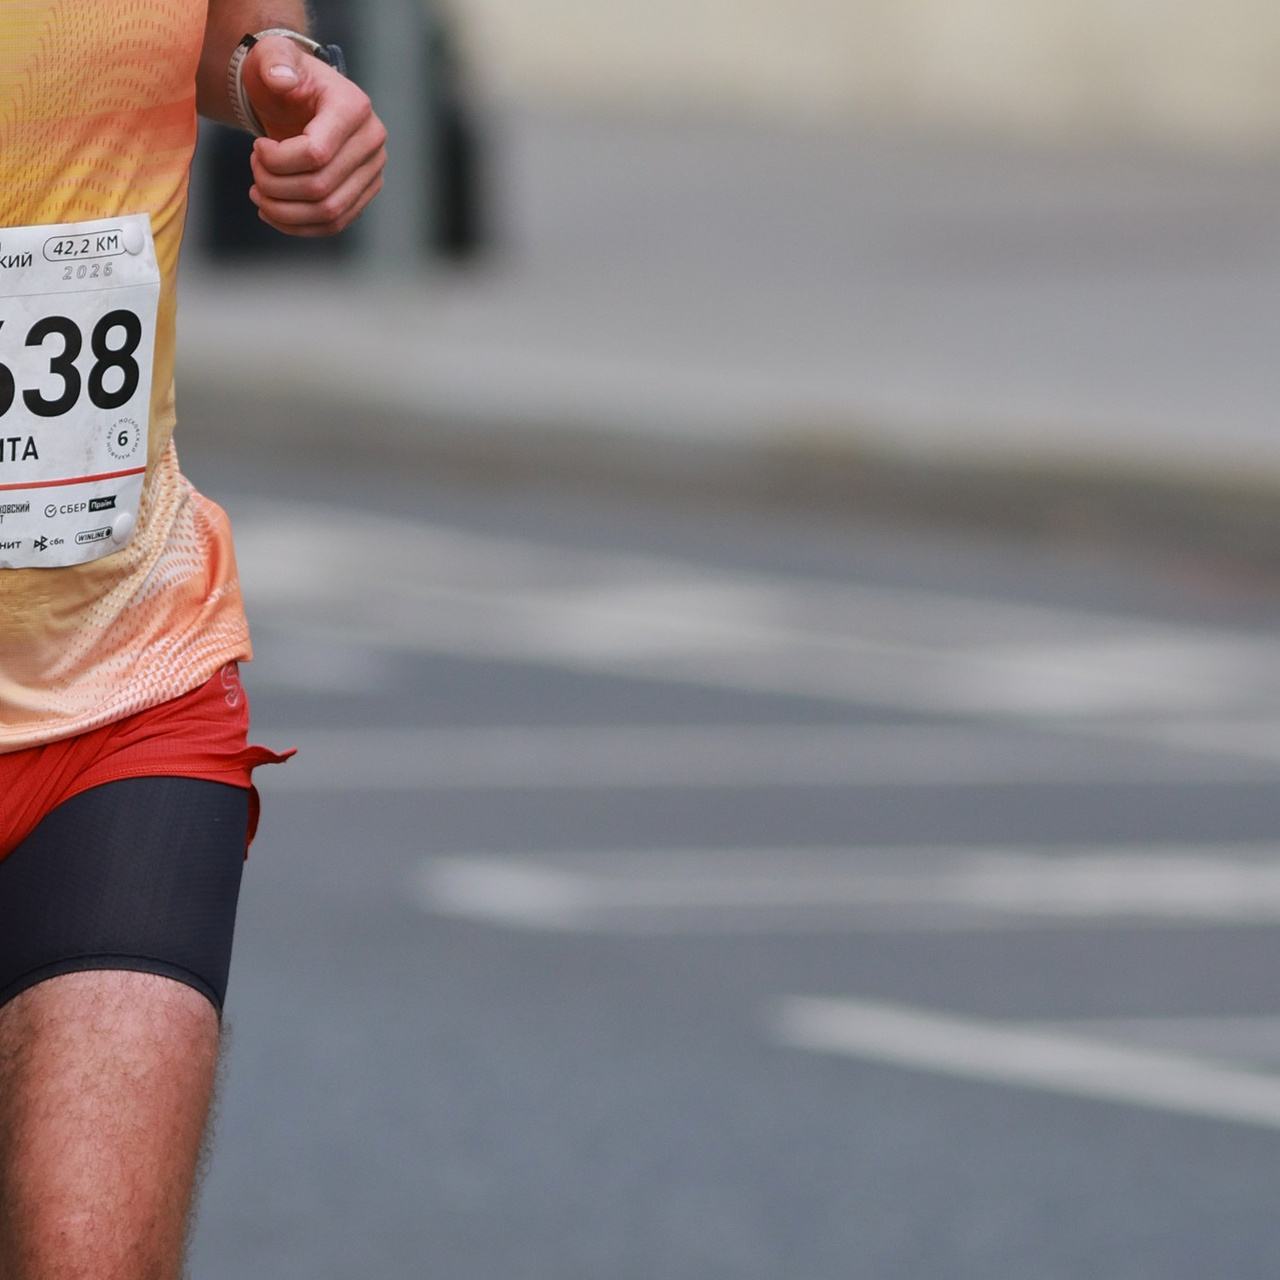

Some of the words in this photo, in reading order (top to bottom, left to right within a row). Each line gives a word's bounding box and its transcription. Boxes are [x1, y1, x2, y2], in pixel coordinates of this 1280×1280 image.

[53, 238, 90, 256] 42,2
[62, 261, 113, 281] 2026
[117, 430, 129, 447] 6
[59, 502, 87, 515] СБЕР
[49, 538, 65, 546] сбп
[78, 530, 106, 542] WINLINE
